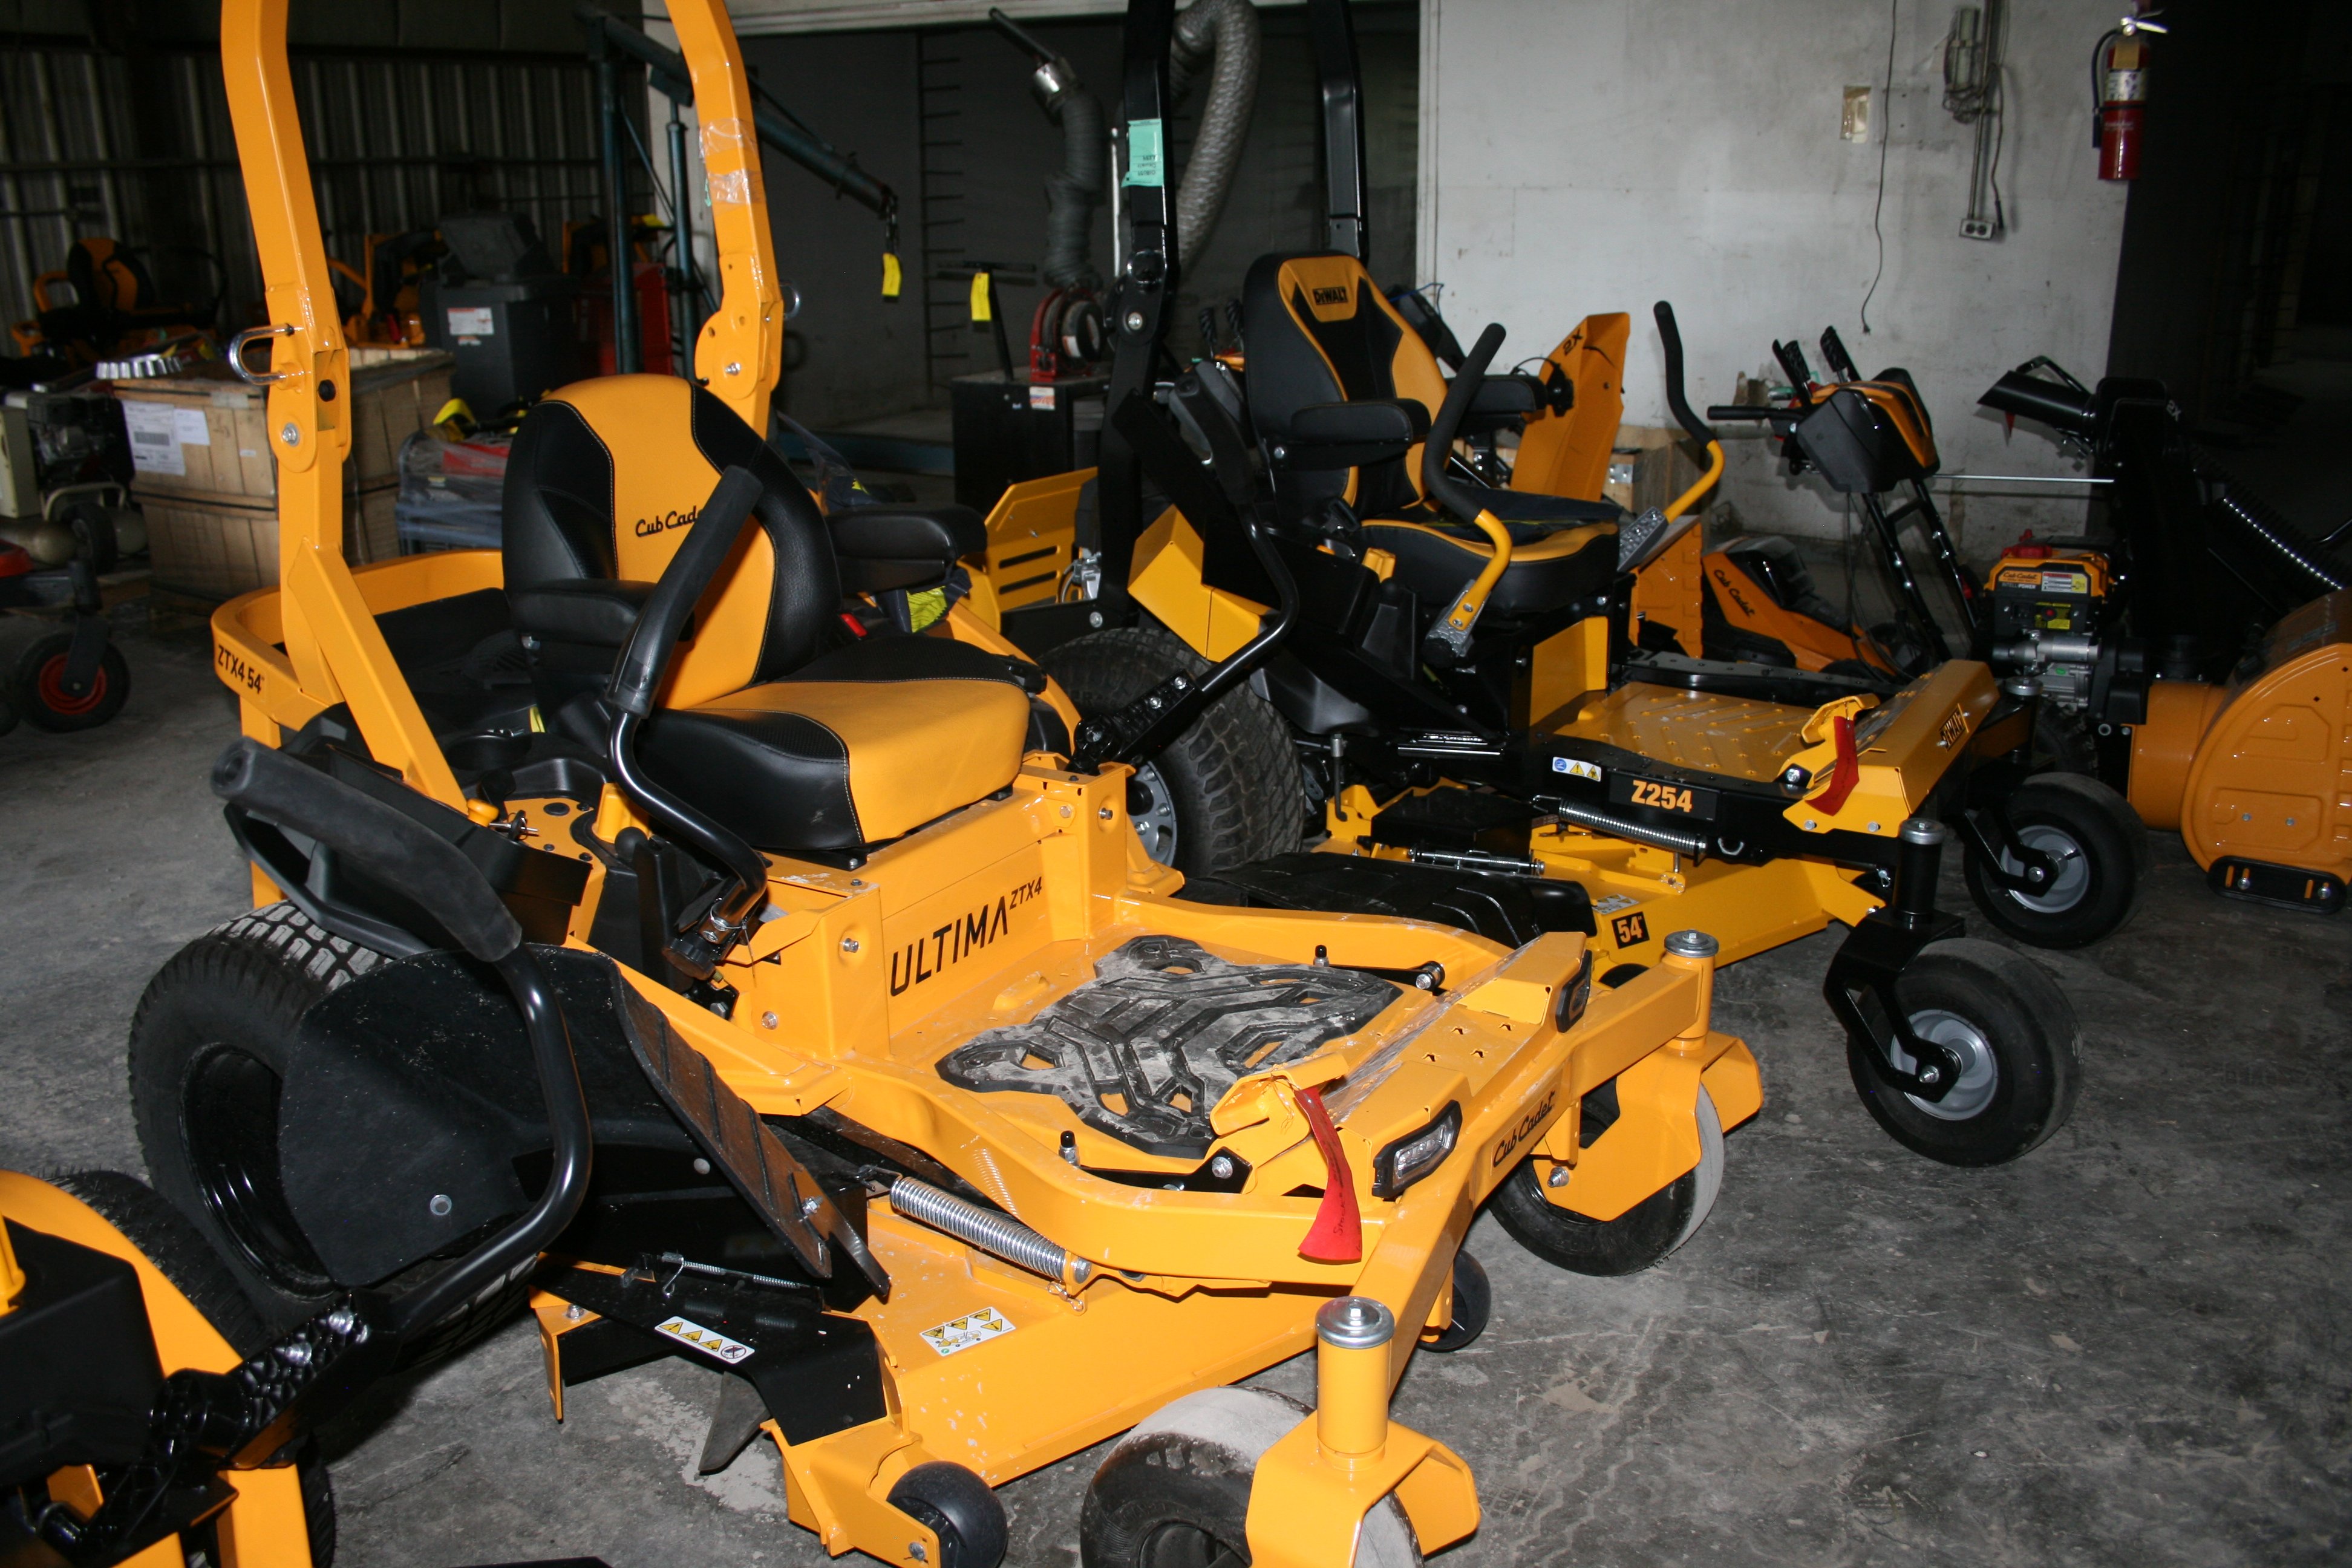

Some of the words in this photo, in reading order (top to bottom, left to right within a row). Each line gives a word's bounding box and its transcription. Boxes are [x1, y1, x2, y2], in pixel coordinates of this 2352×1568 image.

[1563, 327, 1583, 356] 2X
[2166, 399, 2181, 422] 2X
[635, 515, 664, 538] Cub
[665, 505, 697, 529] Cad
[1714, 569, 1731, 587] Cub
[1729, 587, 1755, 618] Cadet
[218, 644, 245, 682] ZTX4
[1631, 779, 1693, 813] Z254
[890, 895, 1008, 996] ULTIMA
[1009, 877, 1042, 910] ZTX4
[1493, 1128, 1517, 1168] Cub
[1518, 1090, 1555, 1142] Cadet
